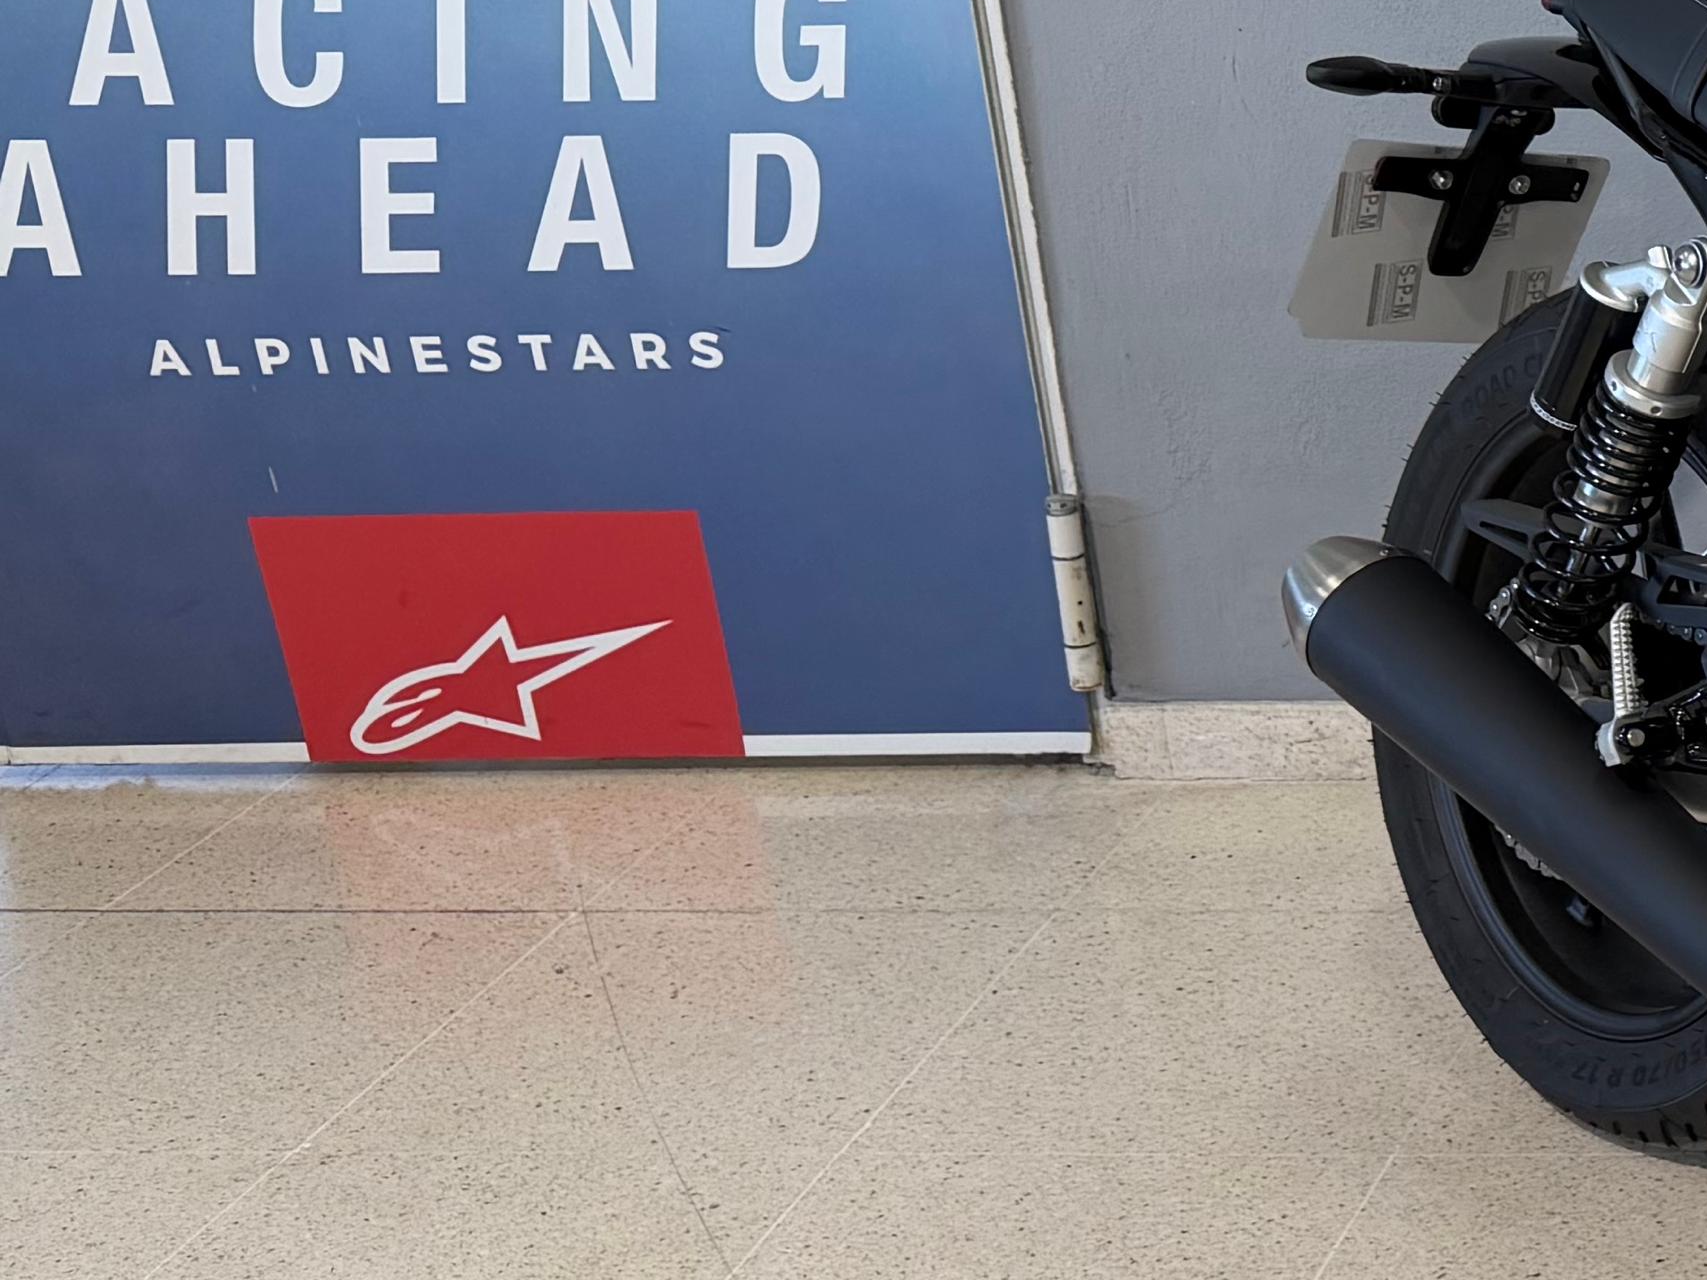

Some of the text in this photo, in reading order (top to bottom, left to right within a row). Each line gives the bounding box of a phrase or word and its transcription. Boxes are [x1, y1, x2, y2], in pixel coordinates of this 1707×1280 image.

[0, 131, 821, 277] AHEAD
[1392, 263, 1417, 319] S-P-M
[149, 329, 727, 378] ALPINESTARS
